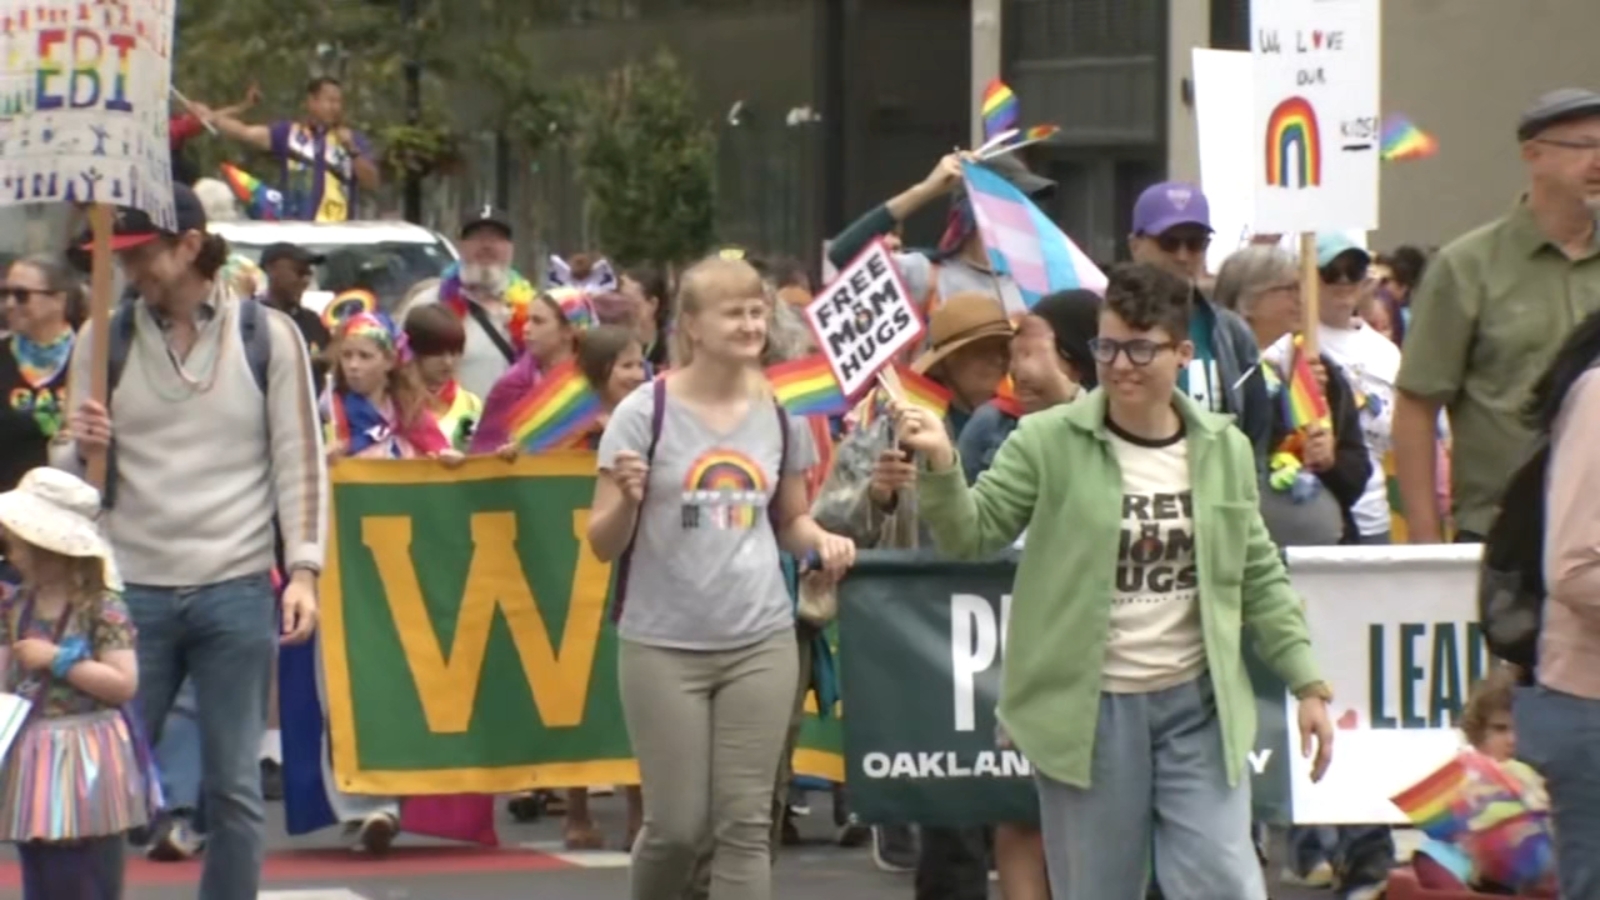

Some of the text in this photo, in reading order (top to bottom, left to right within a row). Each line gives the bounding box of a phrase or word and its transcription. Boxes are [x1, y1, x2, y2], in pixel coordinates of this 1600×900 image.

[815, 252, 888, 329] FREE
[827, 278, 900, 358] MOM
[840, 306, 911, 381] HUGS
[1122, 490, 1193, 519] RE
[1118, 522, 1195, 565] OM
[1116, 564, 1199, 593] UGS
[361, 508, 612, 733] W
[862, 751, 1035, 778] OAKLAN
